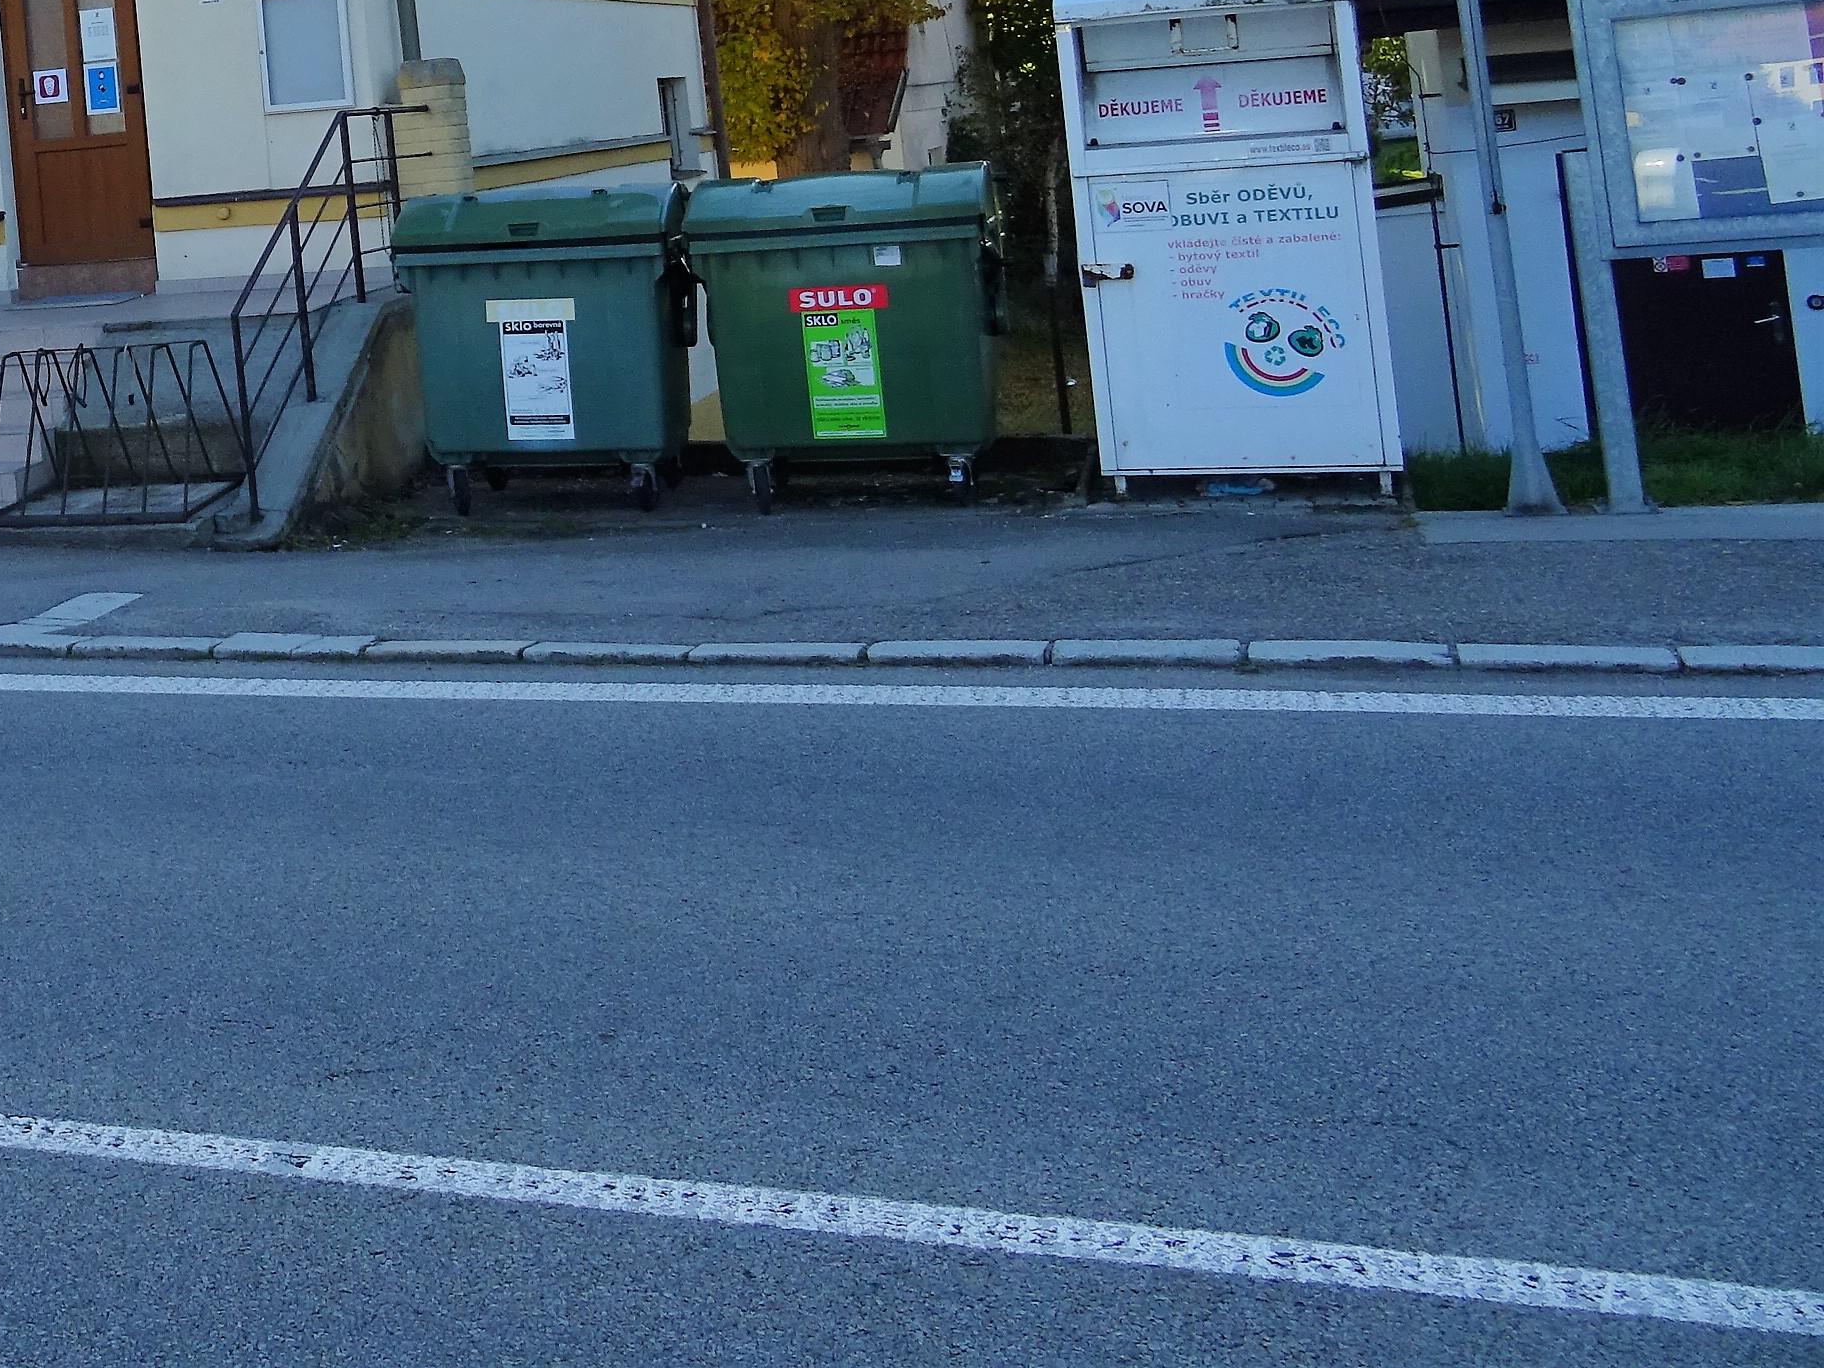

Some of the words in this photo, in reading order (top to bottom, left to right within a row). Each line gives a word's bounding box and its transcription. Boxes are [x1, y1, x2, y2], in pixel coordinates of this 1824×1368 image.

[1238, 88, 1327, 108] DĚKUJEME
[1098, 98, 1184, 118] DĚKUJEME
[1186, 189, 1230, 205] Sběr
[1122, 200, 1168, 214] SOVA
[1236, 213, 1247, 224] a
[1253, 205, 1339, 223] TEXTILU
[1266, 236, 1274, 244] a
[1178, 249, 1221, 263] bytový
[1180, 277, 1212, 287] obuv
[799, 288, 872, 308] SULO
[1182, 289, 1225, 299] hračky
[806, 314, 838, 326] SKLO
